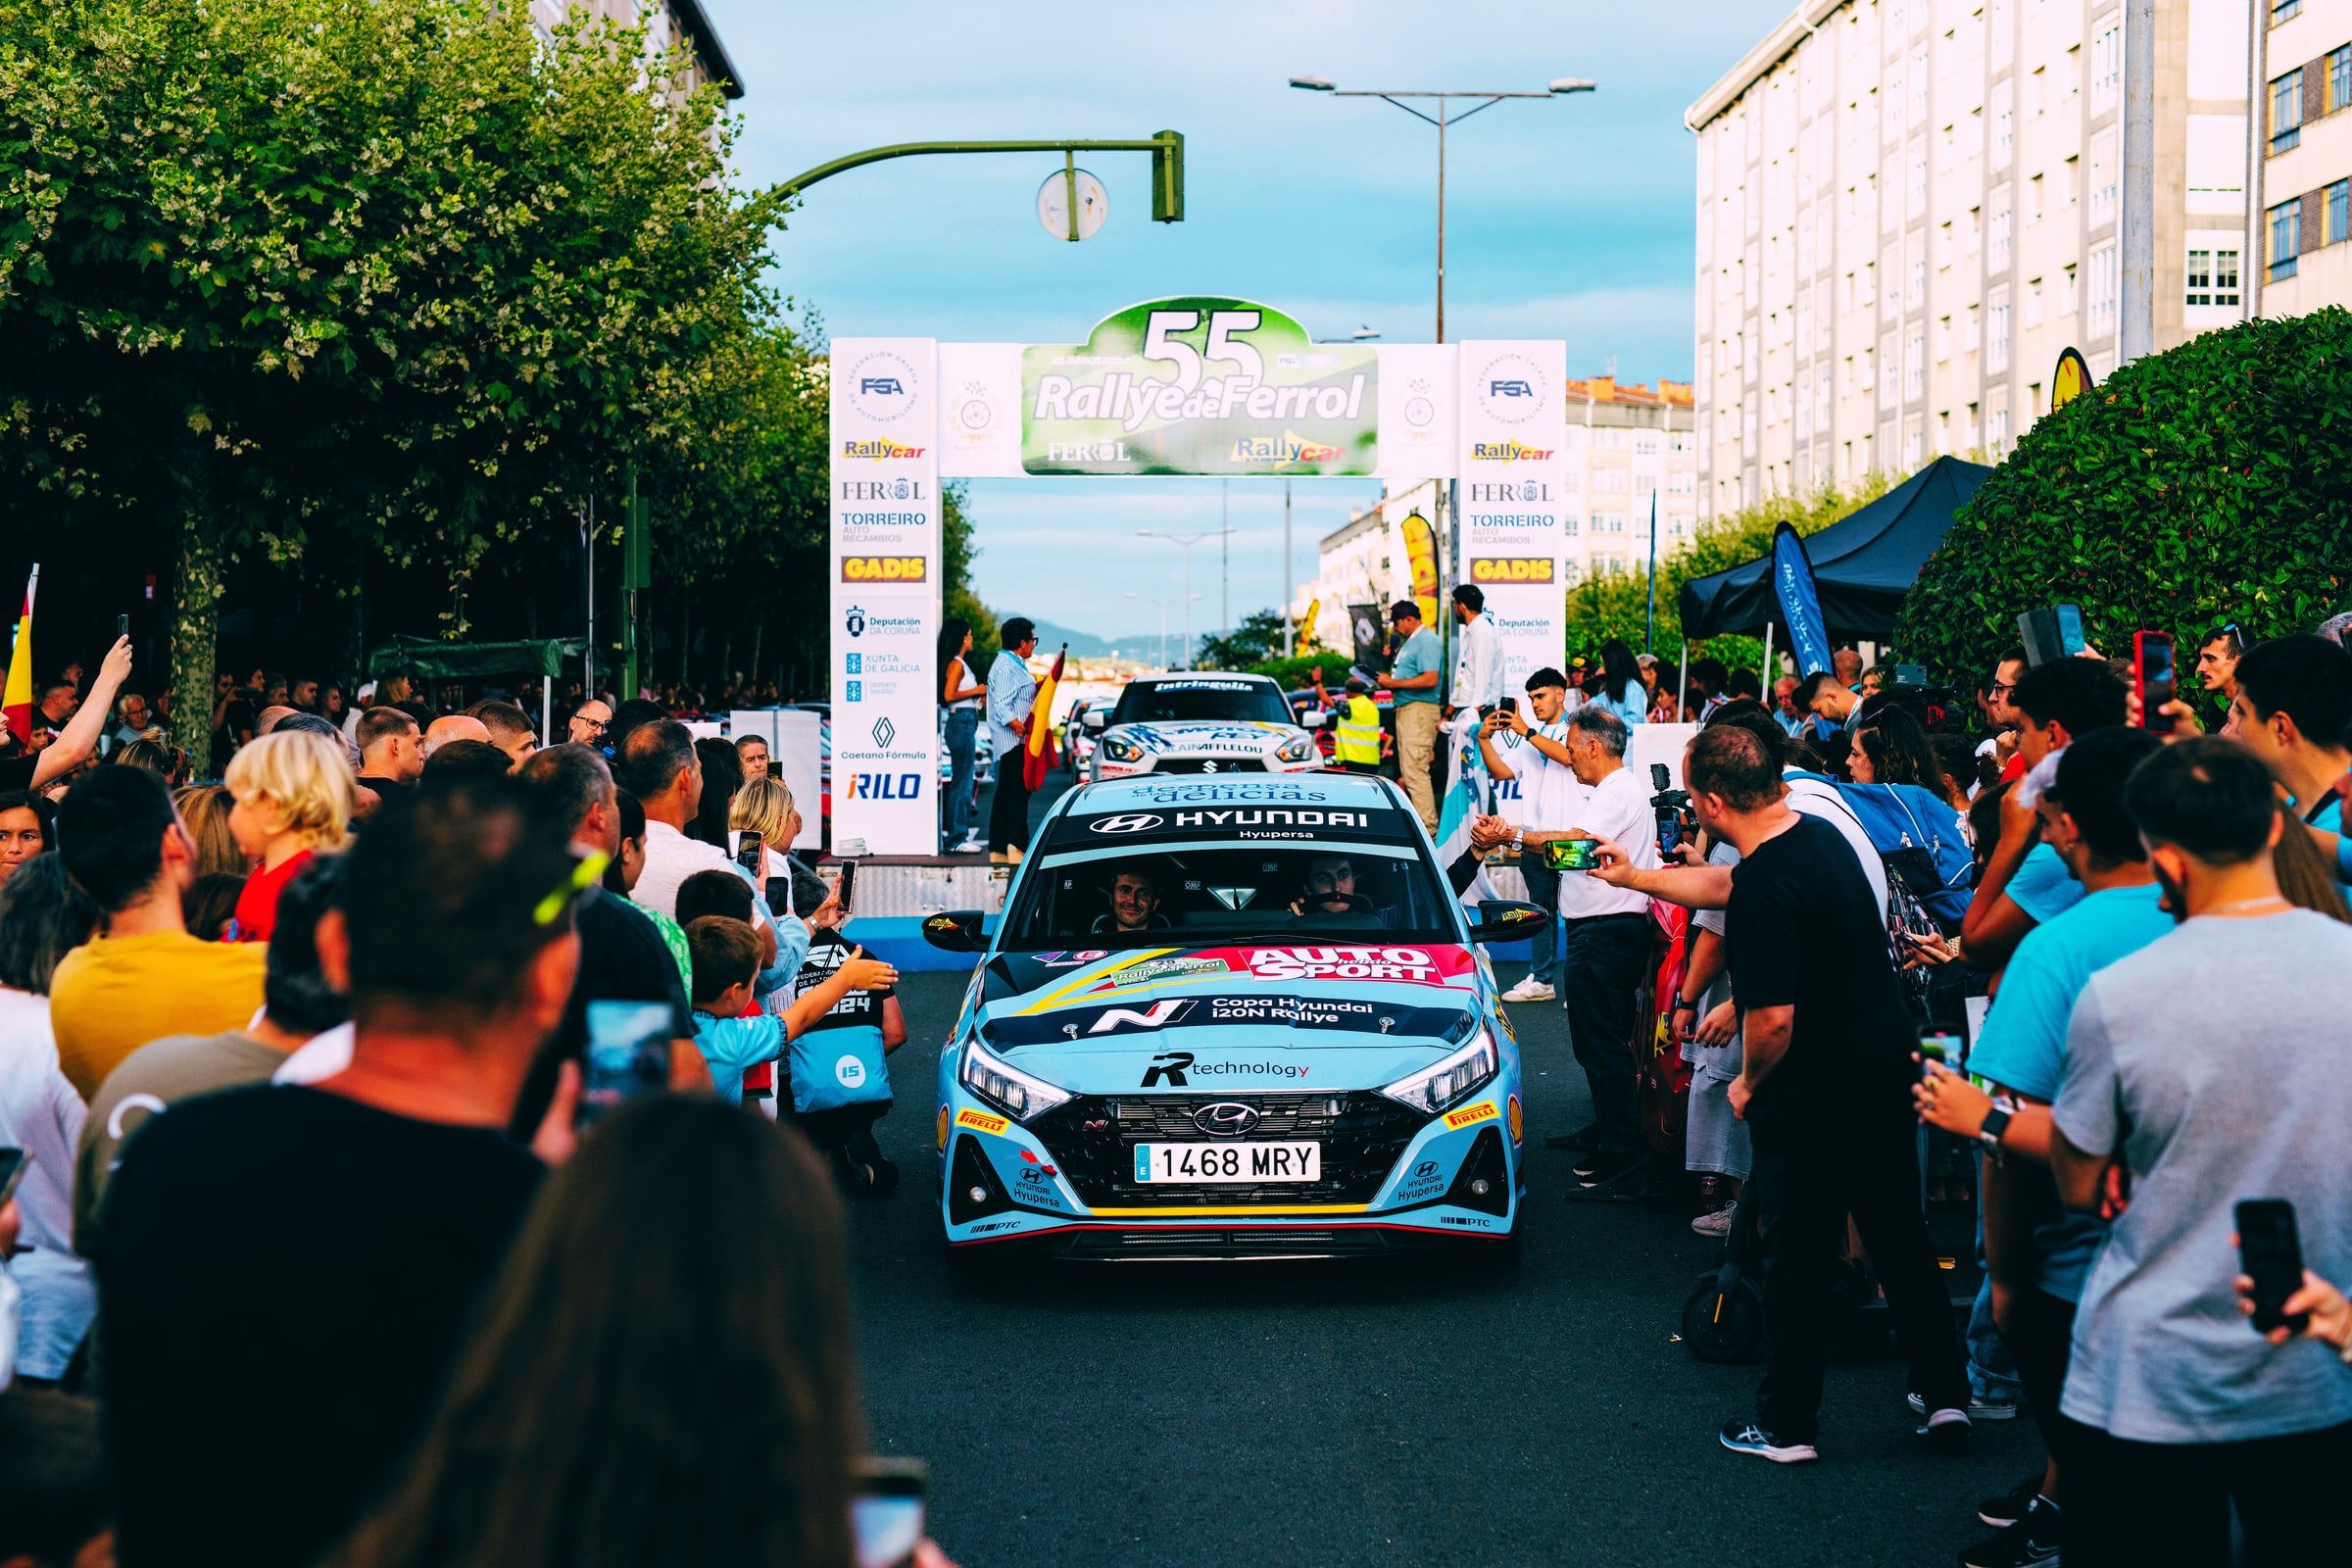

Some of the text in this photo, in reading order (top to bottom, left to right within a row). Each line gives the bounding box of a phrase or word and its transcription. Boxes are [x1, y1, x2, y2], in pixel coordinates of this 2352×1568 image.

[1143, 309, 1264, 392] 55
[841, 513, 926, 525] TORREIRO
[1470, 514, 1554, 527] TORREIRO
[842, 534, 903, 543] RECAMBIOS
[1472, 535, 1531, 544] RECAMBIOS
[844, 557, 926, 580] GADIS
[1473, 559, 1554, 581] GADIS
[869, 616, 921, 627] Deputación
[1498, 617, 1550, 629] Deputación
[884, 625, 921, 636] CORUÑA
[886, 751, 926, 760] Fórmula
[1153, 788, 1327, 803] delicias
[1176, 810, 1368, 828] HYUNDAI
[1240, 830, 1314, 840] Hyupersa
[1250, 948, 1433, 967] AUTO
[1252, 961, 1436, 981] SPORT
[1212, 998, 1373, 1014] Copa Hyundai
[1212, 1007, 1340, 1023] i20N Rallye
[1194, 1059, 1310, 1078] technology
[959, 1110, 1005, 1132] PIRELLI
[1447, 1103, 1495, 1126] PIRELLI
[1162, 1147, 1313, 1178] 1468 MRY
[1140, 1166, 1147, 1176] E
[1015, 1181, 1051, 1196] HYUNDAI
[1407, 1174, 1444, 1189] HYUNDAI
[1013, 1187, 1060, 1208] Hyupersa
[1397, 1183, 1445, 1201] Hyupersa
[996, 1221, 1021, 1230] PTC
[1467, 1218, 1491, 1227] PTC
